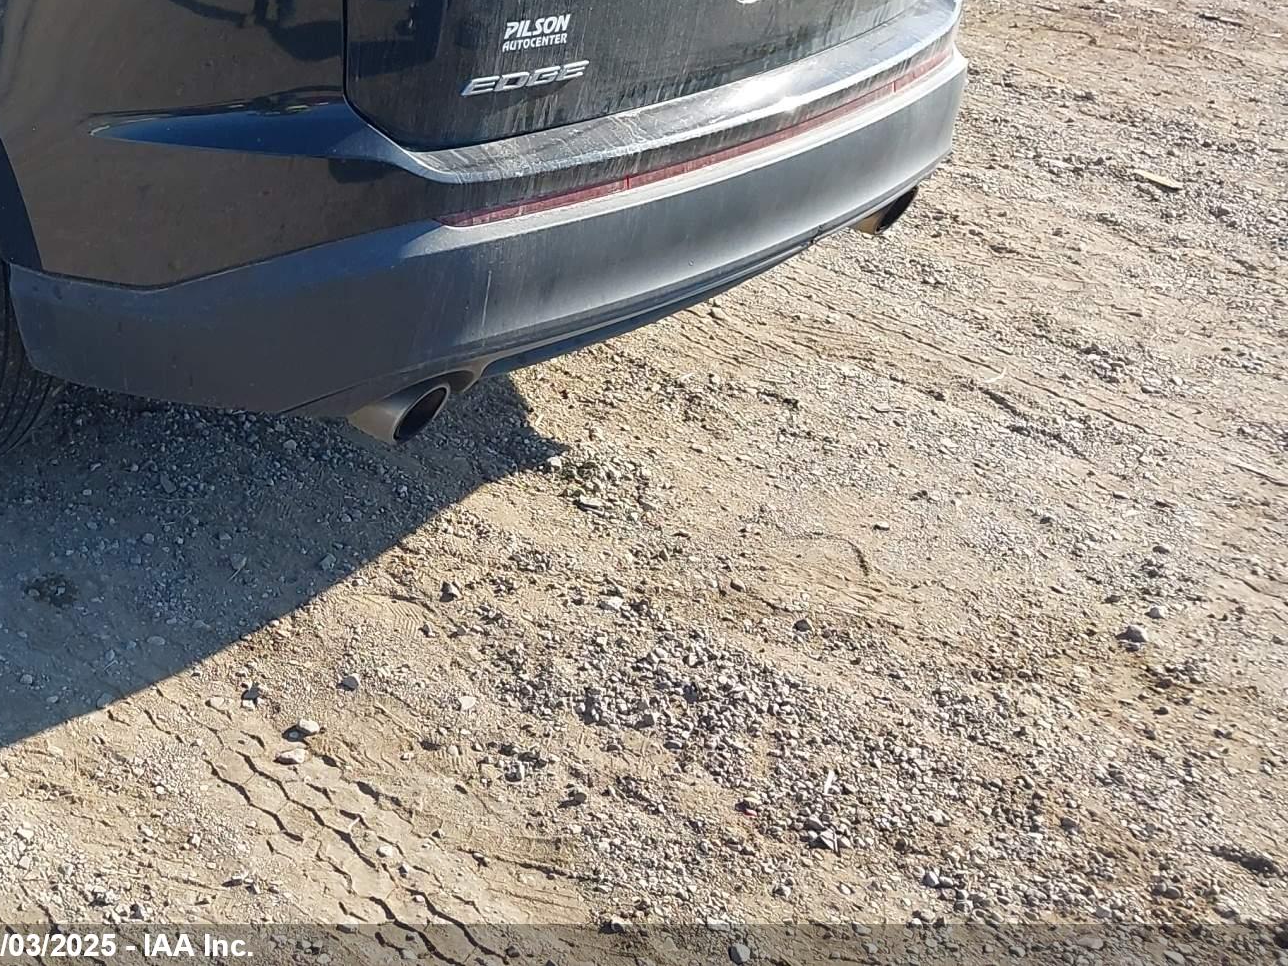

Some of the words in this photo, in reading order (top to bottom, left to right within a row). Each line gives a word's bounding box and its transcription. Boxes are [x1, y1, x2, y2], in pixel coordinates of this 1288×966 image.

[503, 13, 571, 40] PILSON
[502, 32, 568, 52] AUTOCENTER
[461, 59, 590, 97] EDGE
